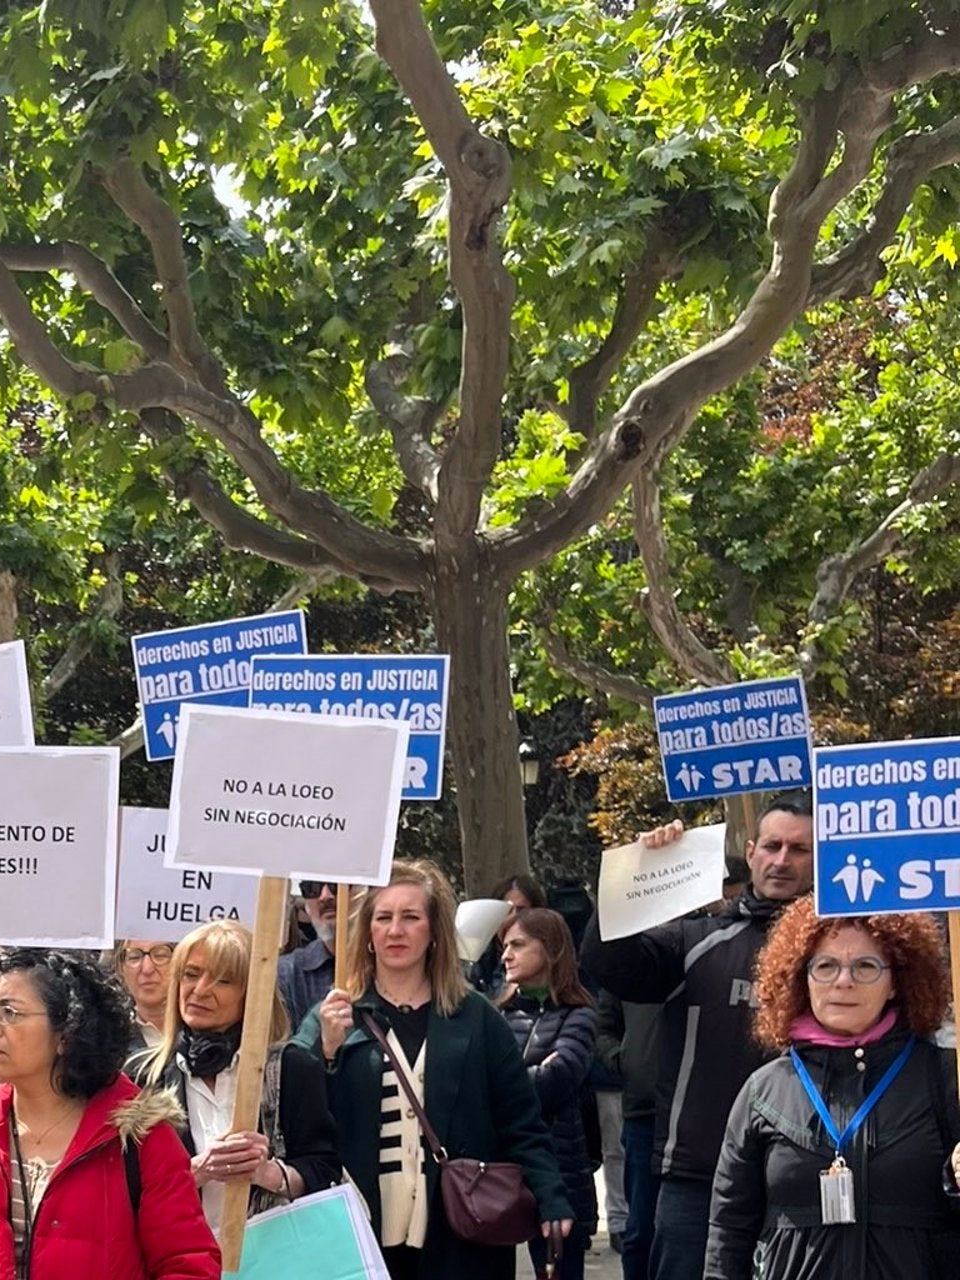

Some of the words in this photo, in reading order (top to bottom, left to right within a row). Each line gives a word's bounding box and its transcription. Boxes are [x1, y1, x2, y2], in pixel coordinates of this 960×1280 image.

[138, 638, 209, 666] derechos
[212, 636, 232, 655] en
[236, 623, 298, 650] JUSTICIA
[140, 670, 194, 705] para
[199, 658, 251, 692] todo
[253, 669, 336, 691] derechos
[340, 672, 362, 691] en
[367, 669, 438, 691] JUSTICIA
[658, 701, 720, 723] derechos
[723, 697, 740, 712] en
[744, 687, 798, 710] JUSTICIA
[661, 726, 707, 755] para
[712, 712, 806, 745] todos/as
[712, 755, 802, 789] STAR
[817, 758, 928, 790] derechos
[933, 757, 960, 780] en
[223, 779, 248, 794] NO
[252, 781, 263, 795] A
[268, 782, 286, 796] LA
[291, 785, 334, 800] LOEO
[204, 808, 230, 823] SIN
[235, 810, 346, 831] NEGOCIACIÓN
[818, 798, 897, 842] para
[52, 826, 75, 843] DE
[182, 870, 213, 890] EN
[633, 873, 647, 882] NO
[650, 872, 656, 880] A
[658, 867, 669, 877] LA
[899, 858, 960, 900] ST
[626, 891, 641, 900] SIN
[146, 901, 240, 923] HUELGA
